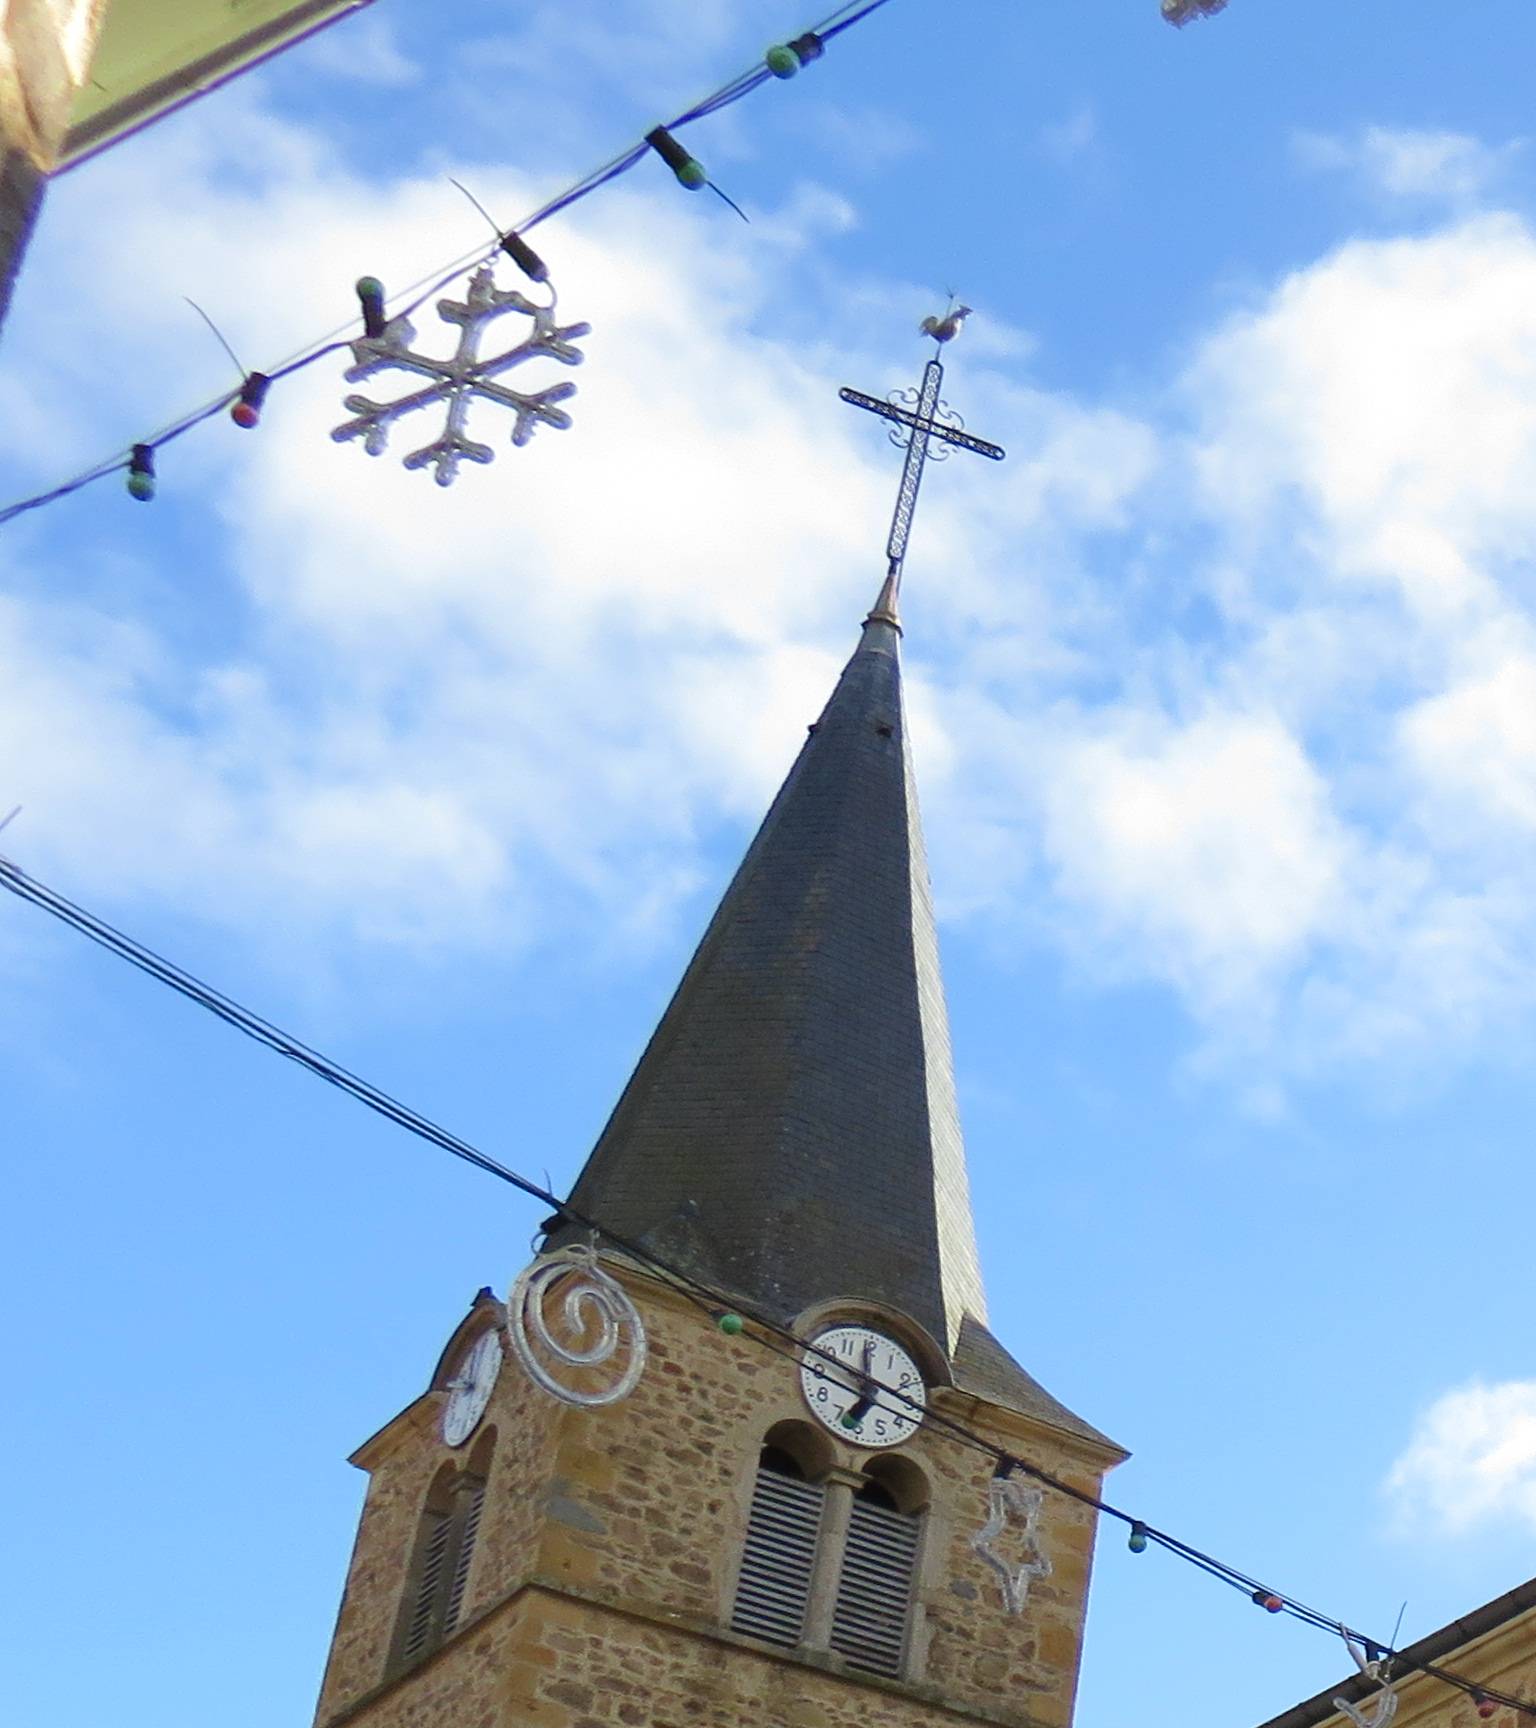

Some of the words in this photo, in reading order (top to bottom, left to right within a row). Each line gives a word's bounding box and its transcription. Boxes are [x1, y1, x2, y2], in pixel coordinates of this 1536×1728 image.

[841, 1339, 855, 1356] 11
[887, 1354, 895, 1370] 1
[899, 1373, 912, 1389] 2
[817, 1387, 829, 1402] 8
[833, 1404, 845, 1420] 7
[875, 1420, 887, 1435] 5
[892, 1415, 905, 1430] 4
